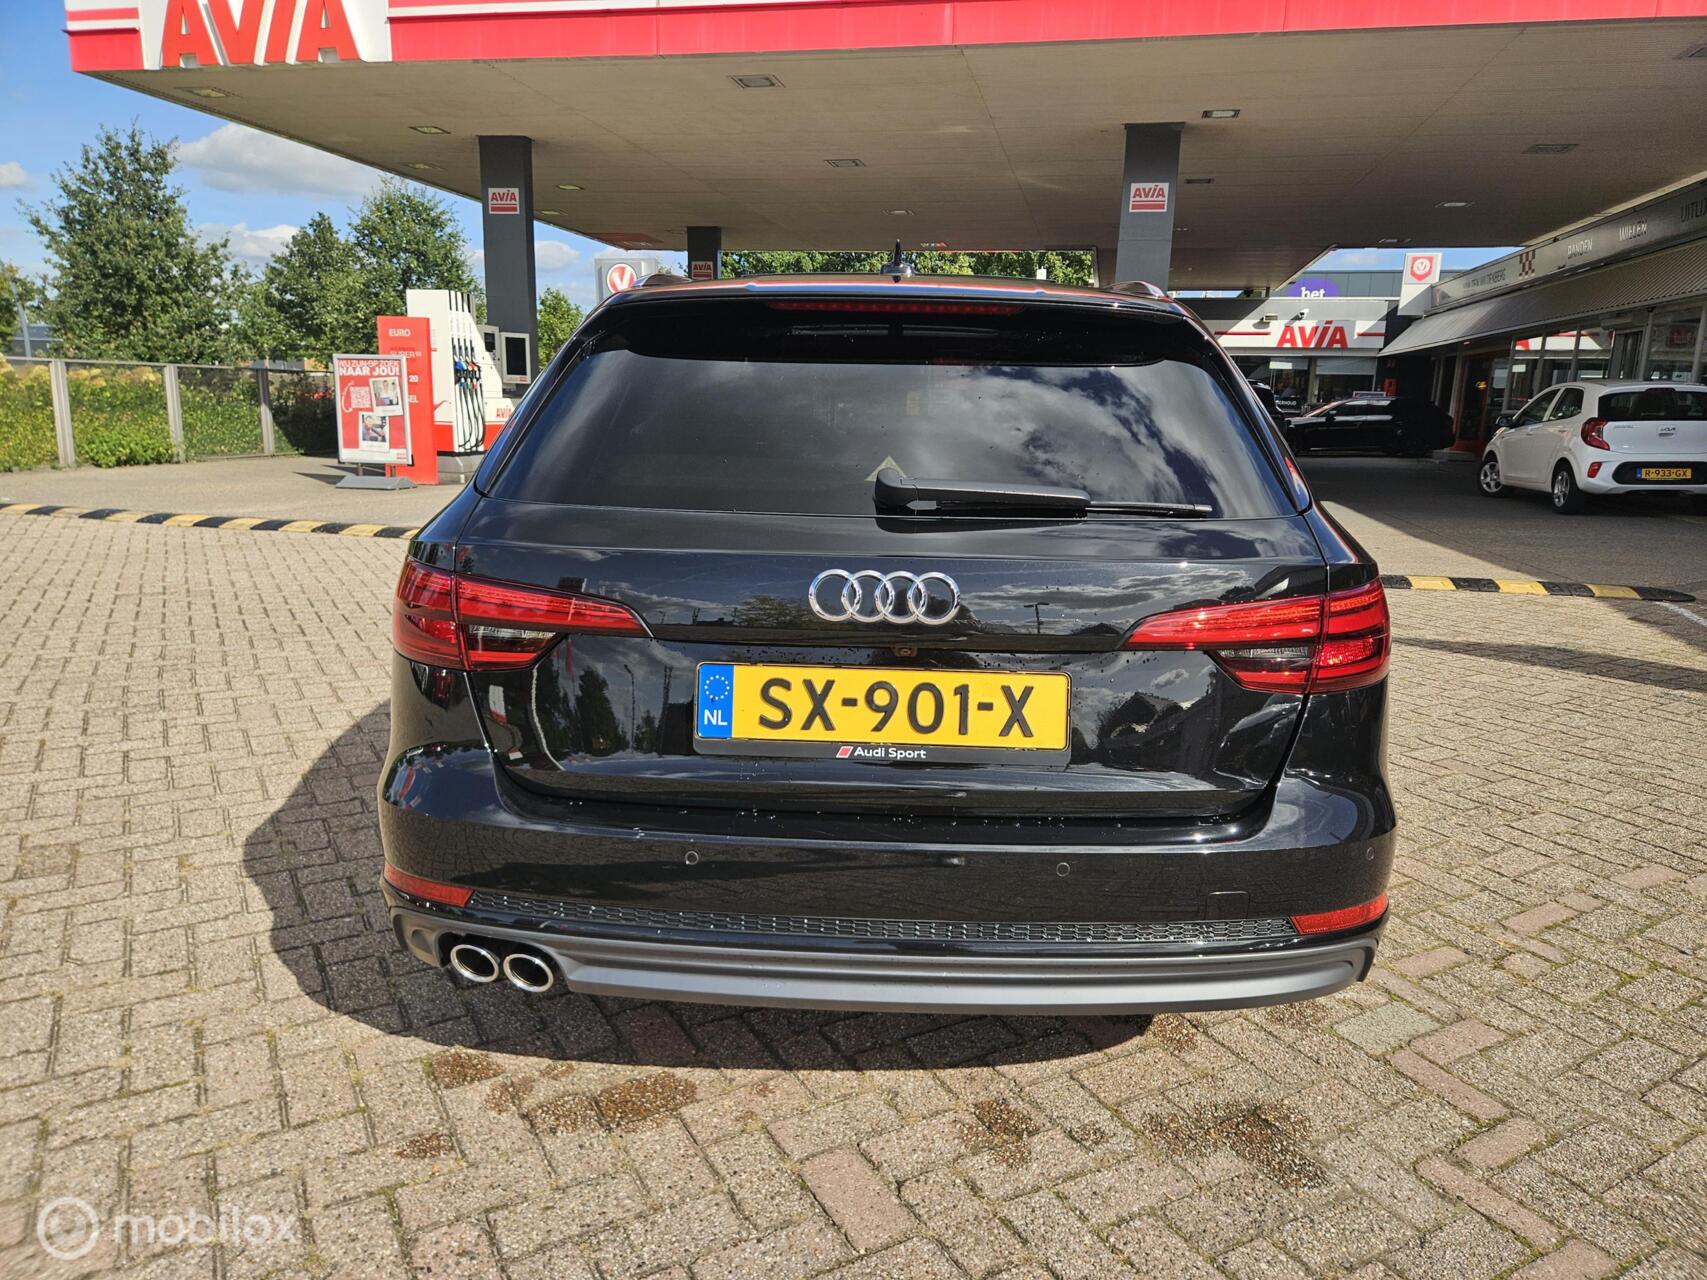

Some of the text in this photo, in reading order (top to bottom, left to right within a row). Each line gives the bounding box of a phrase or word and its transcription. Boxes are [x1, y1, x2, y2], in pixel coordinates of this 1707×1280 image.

[160, 0, 361, 67] AVIA
[490, 189, 517, 202] AVIA
[1132, 185, 1166, 198] AVIA
[693, 262, 712, 271] AVIA
[388, 327, 412, 337] EURO
[1276, 320, 1349, 348] AVIA
[339, 366, 400, 376] NAAR JOU!
[1643, 469, 1689, 478] R-933-GX
[757, 677, 1035, 738] SX-901-X
[703, 708, 728, 726] NL
[853, 746, 927, 760] Audi Sport
